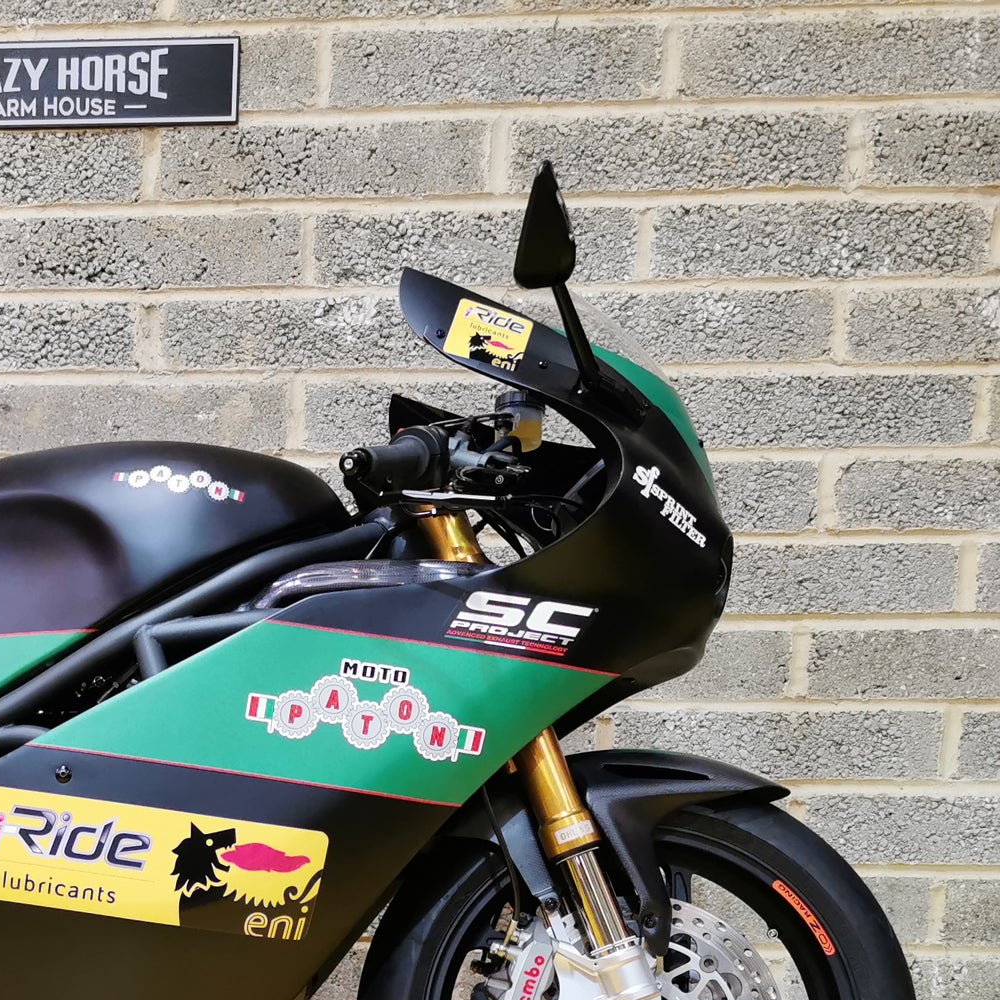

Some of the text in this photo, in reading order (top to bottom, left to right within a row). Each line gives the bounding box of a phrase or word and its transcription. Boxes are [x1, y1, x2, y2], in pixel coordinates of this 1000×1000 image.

[58, 48, 169, 100] HORSE
[43, 97, 117, 117] HOUSE
[469, 322, 510, 340] lubricants
[491, 357, 517, 373] eni
[131, 467, 226, 499] PATON
[650, 483, 697, 526] SPRINT
[660, 504, 707, 548] FILTER
[456, 590, 594, 638] SC
[445, 629, 569, 653] ADVANCED EXHAUST TECHNOLOGY
[450, 619, 575, 646] PROJECT
[342, 660, 408, 685] MOTO
[281, 682, 453, 755] PATON
[2, 870, 117, 905] lubricants
[777, 883, 812, 919] RACING
[244, 906, 309, 941] eni
